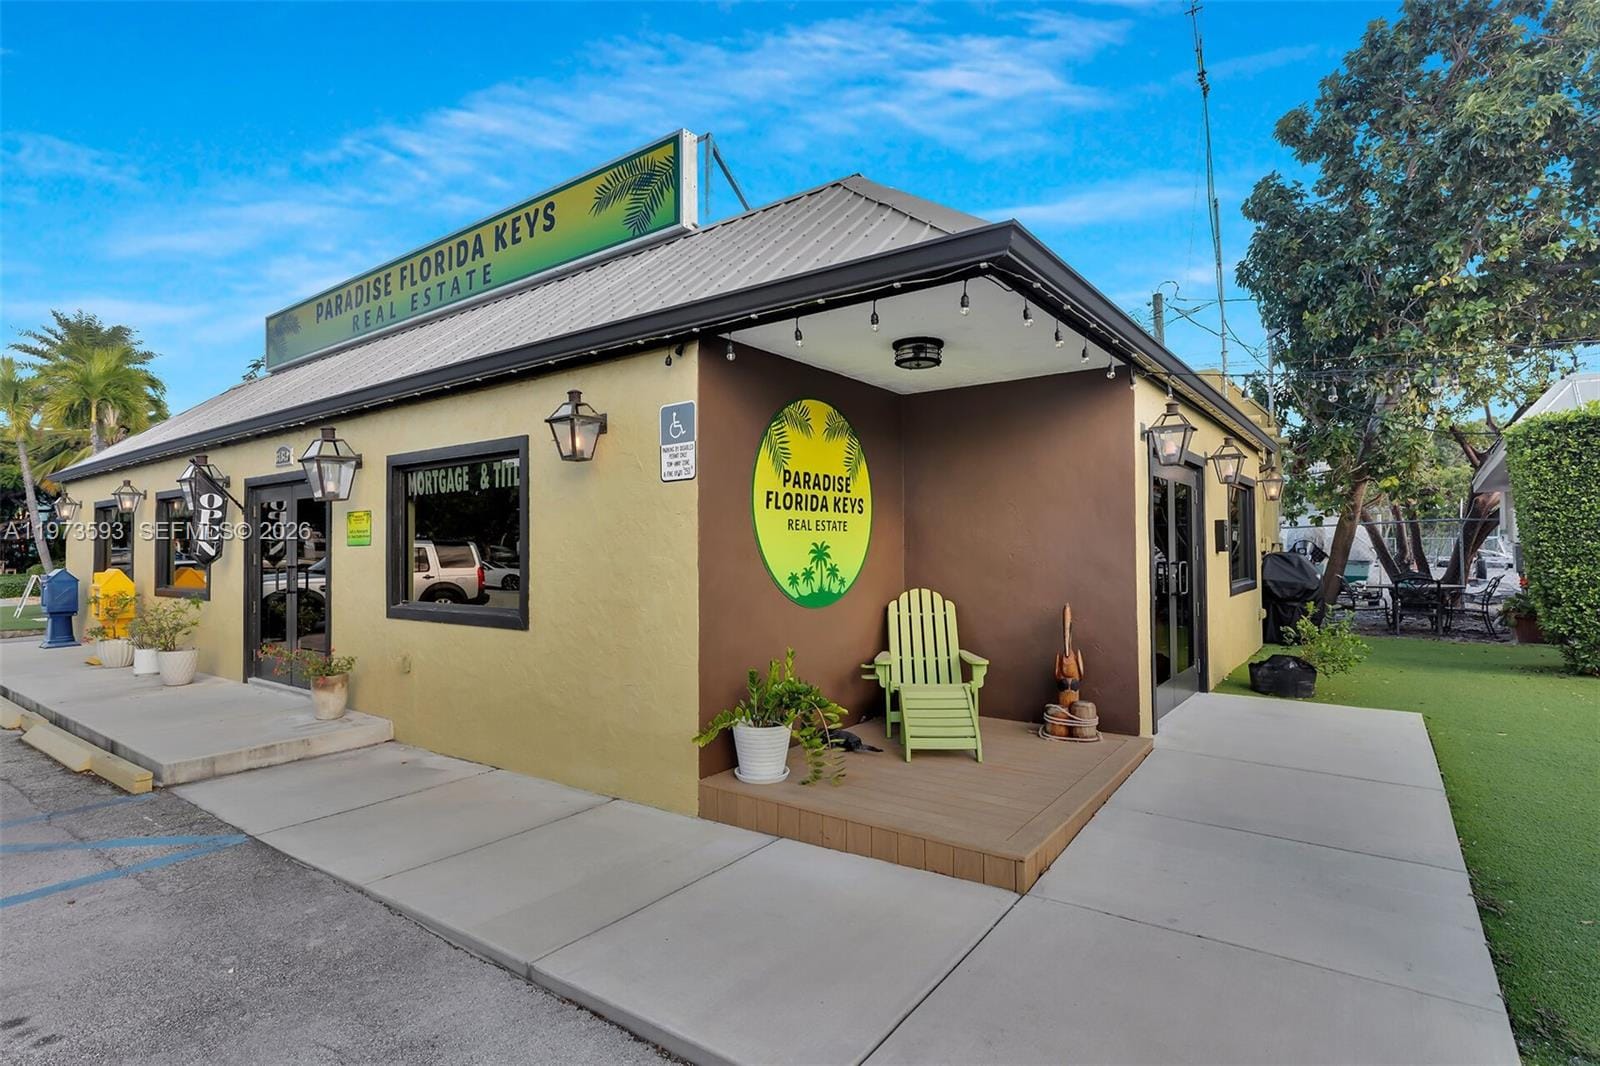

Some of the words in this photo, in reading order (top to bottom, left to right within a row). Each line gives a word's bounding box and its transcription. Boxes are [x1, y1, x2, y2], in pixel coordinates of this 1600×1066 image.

[316, 272, 392, 324] PARADISE
[400, 233, 484, 291] FLORIDA
[494, 201, 556, 252] KEYS
[352, 301, 396, 332] REAL
[410, 263, 492, 312] ESTATE
[407, 465, 469, 497] MORTGAGE
[480, 463, 490, 490] &
[782, 469, 851, 493] PARADISE
[765, 490, 829, 513] FLORIDA
[833, 496, 864, 515] KEYS
[195, 493, 223, 556] OPEN
[787, 518, 812, 531] REAL
[815, 519, 848, 532] ESTATE
